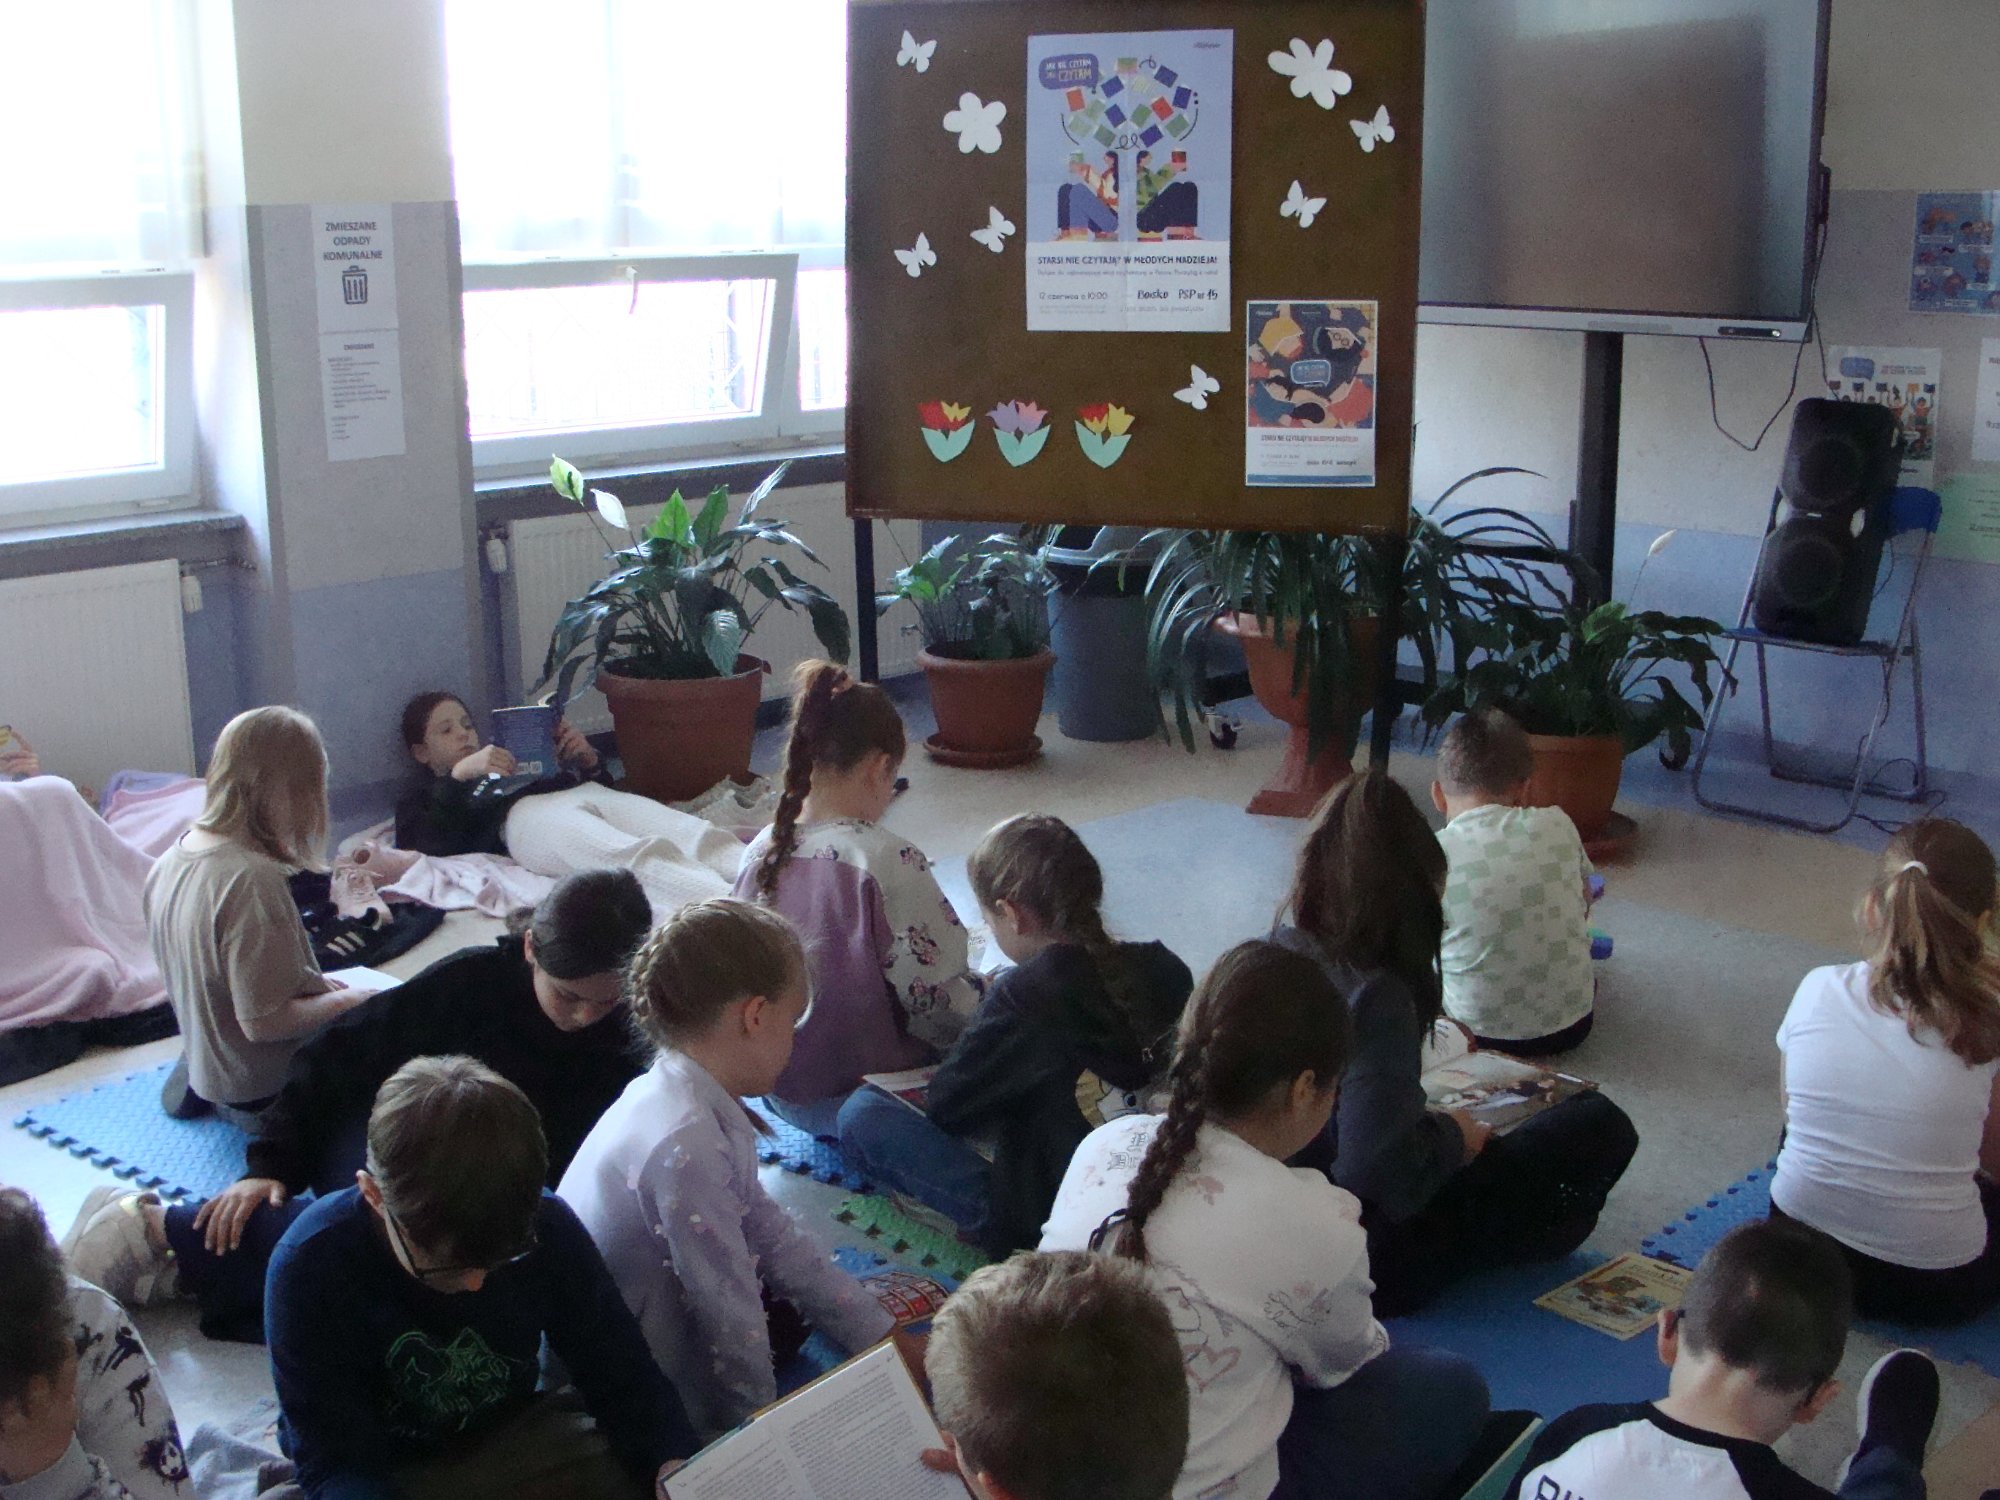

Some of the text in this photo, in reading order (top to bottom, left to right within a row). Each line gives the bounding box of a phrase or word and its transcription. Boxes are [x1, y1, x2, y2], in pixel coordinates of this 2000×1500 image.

[325, 221, 377, 231] ZMIESZANE
[333, 235, 371, 246] ODPADY
[323, 250, 383, 261] KOMUNALNE
[1038, 255, 1218, 267] STARSI NIE CZYTAJĄ? W MŁODYCH NADZIEJA!
[1178, 288, 1197, 300] PSP
